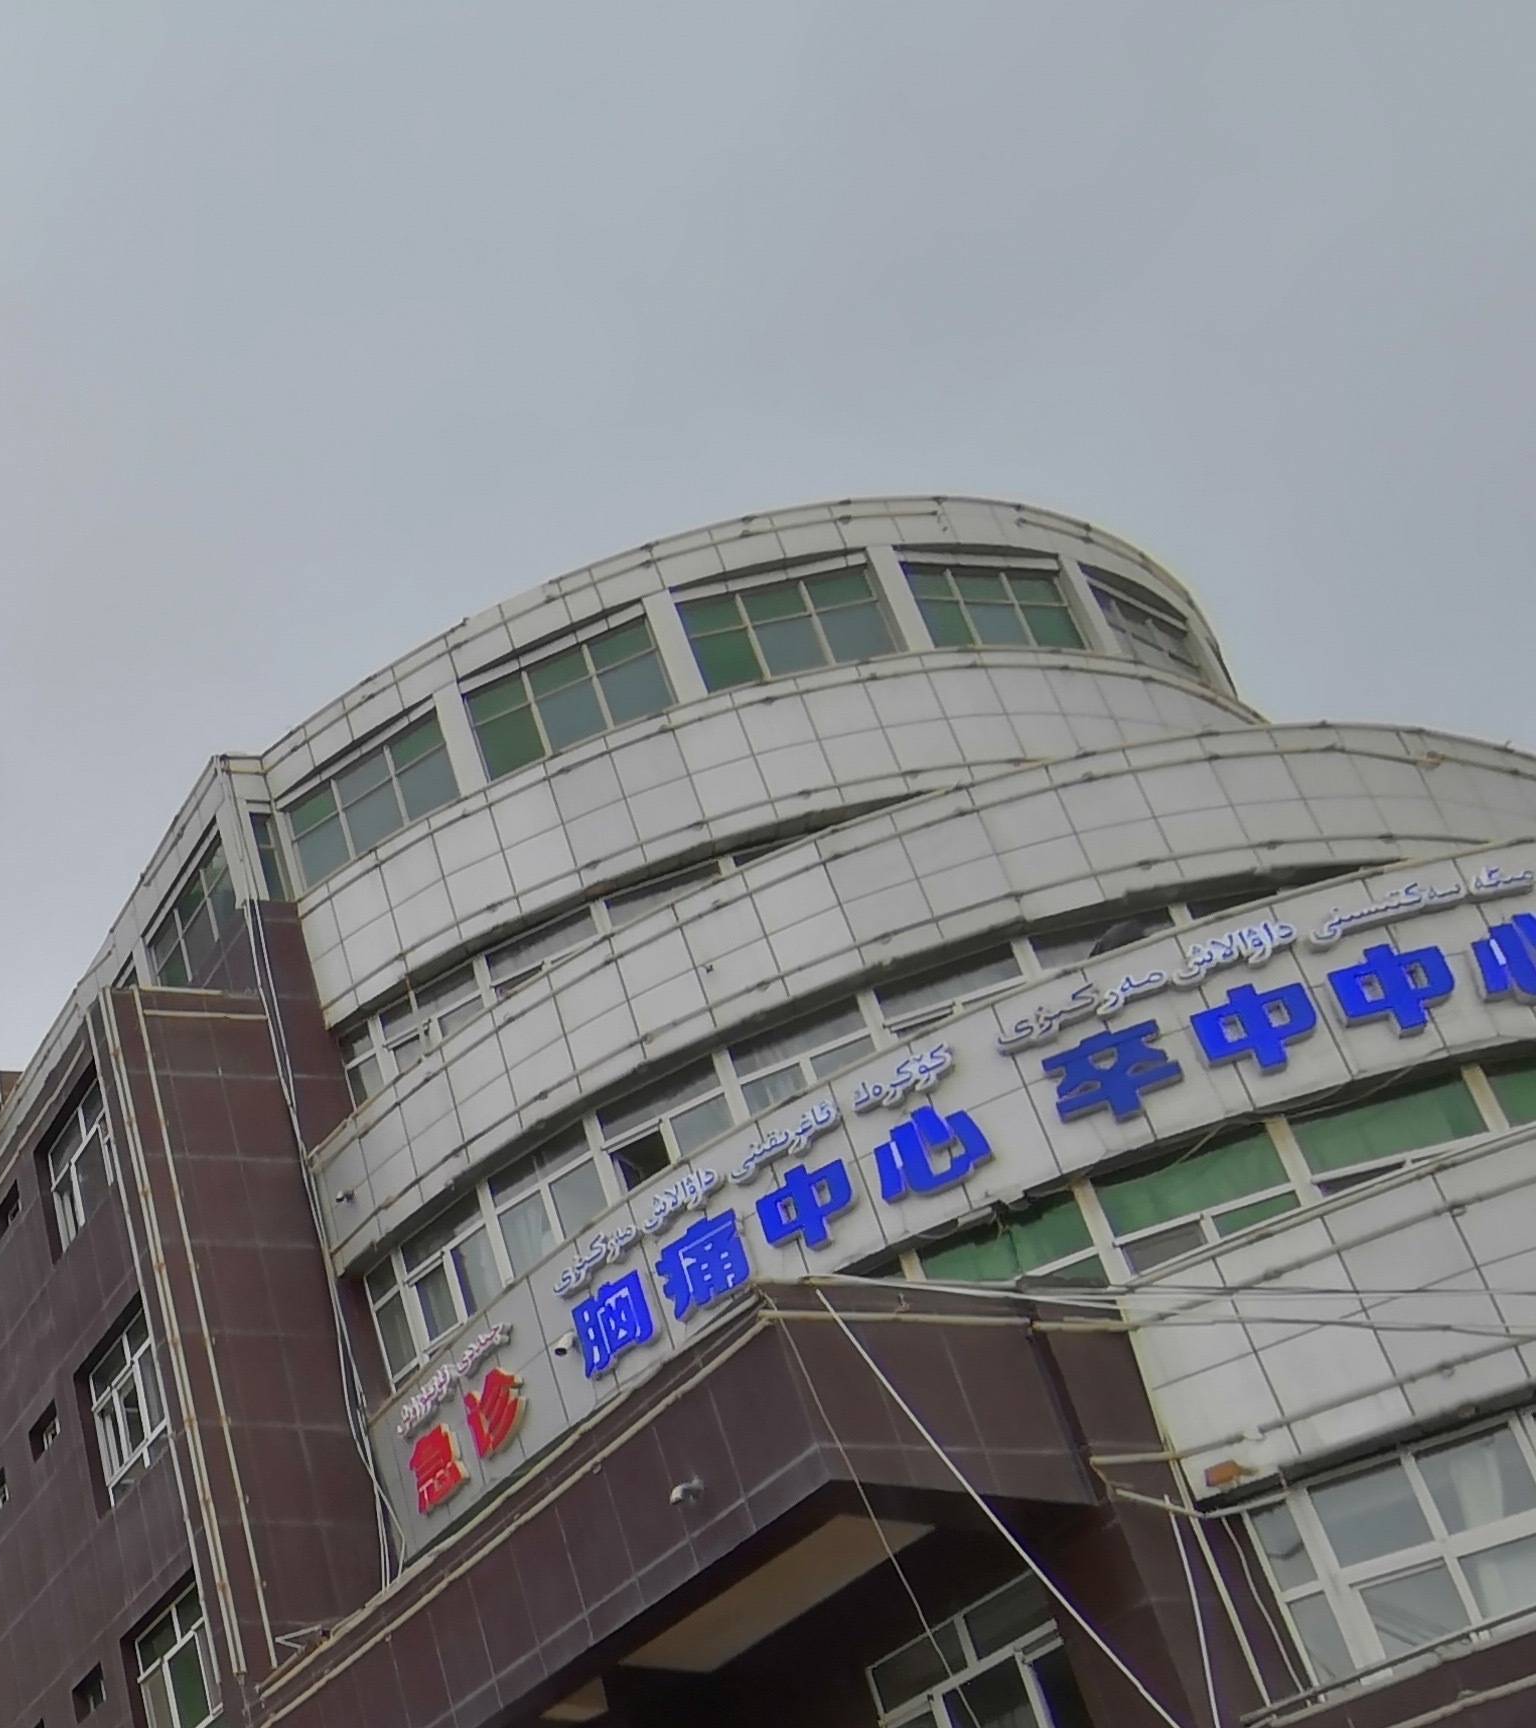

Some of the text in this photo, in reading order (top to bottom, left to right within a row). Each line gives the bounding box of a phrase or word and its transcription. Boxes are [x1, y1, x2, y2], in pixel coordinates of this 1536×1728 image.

[571, 1105, 993, 1379] 胸痛中心
[409, 1367, 526, 1516] 急诊
